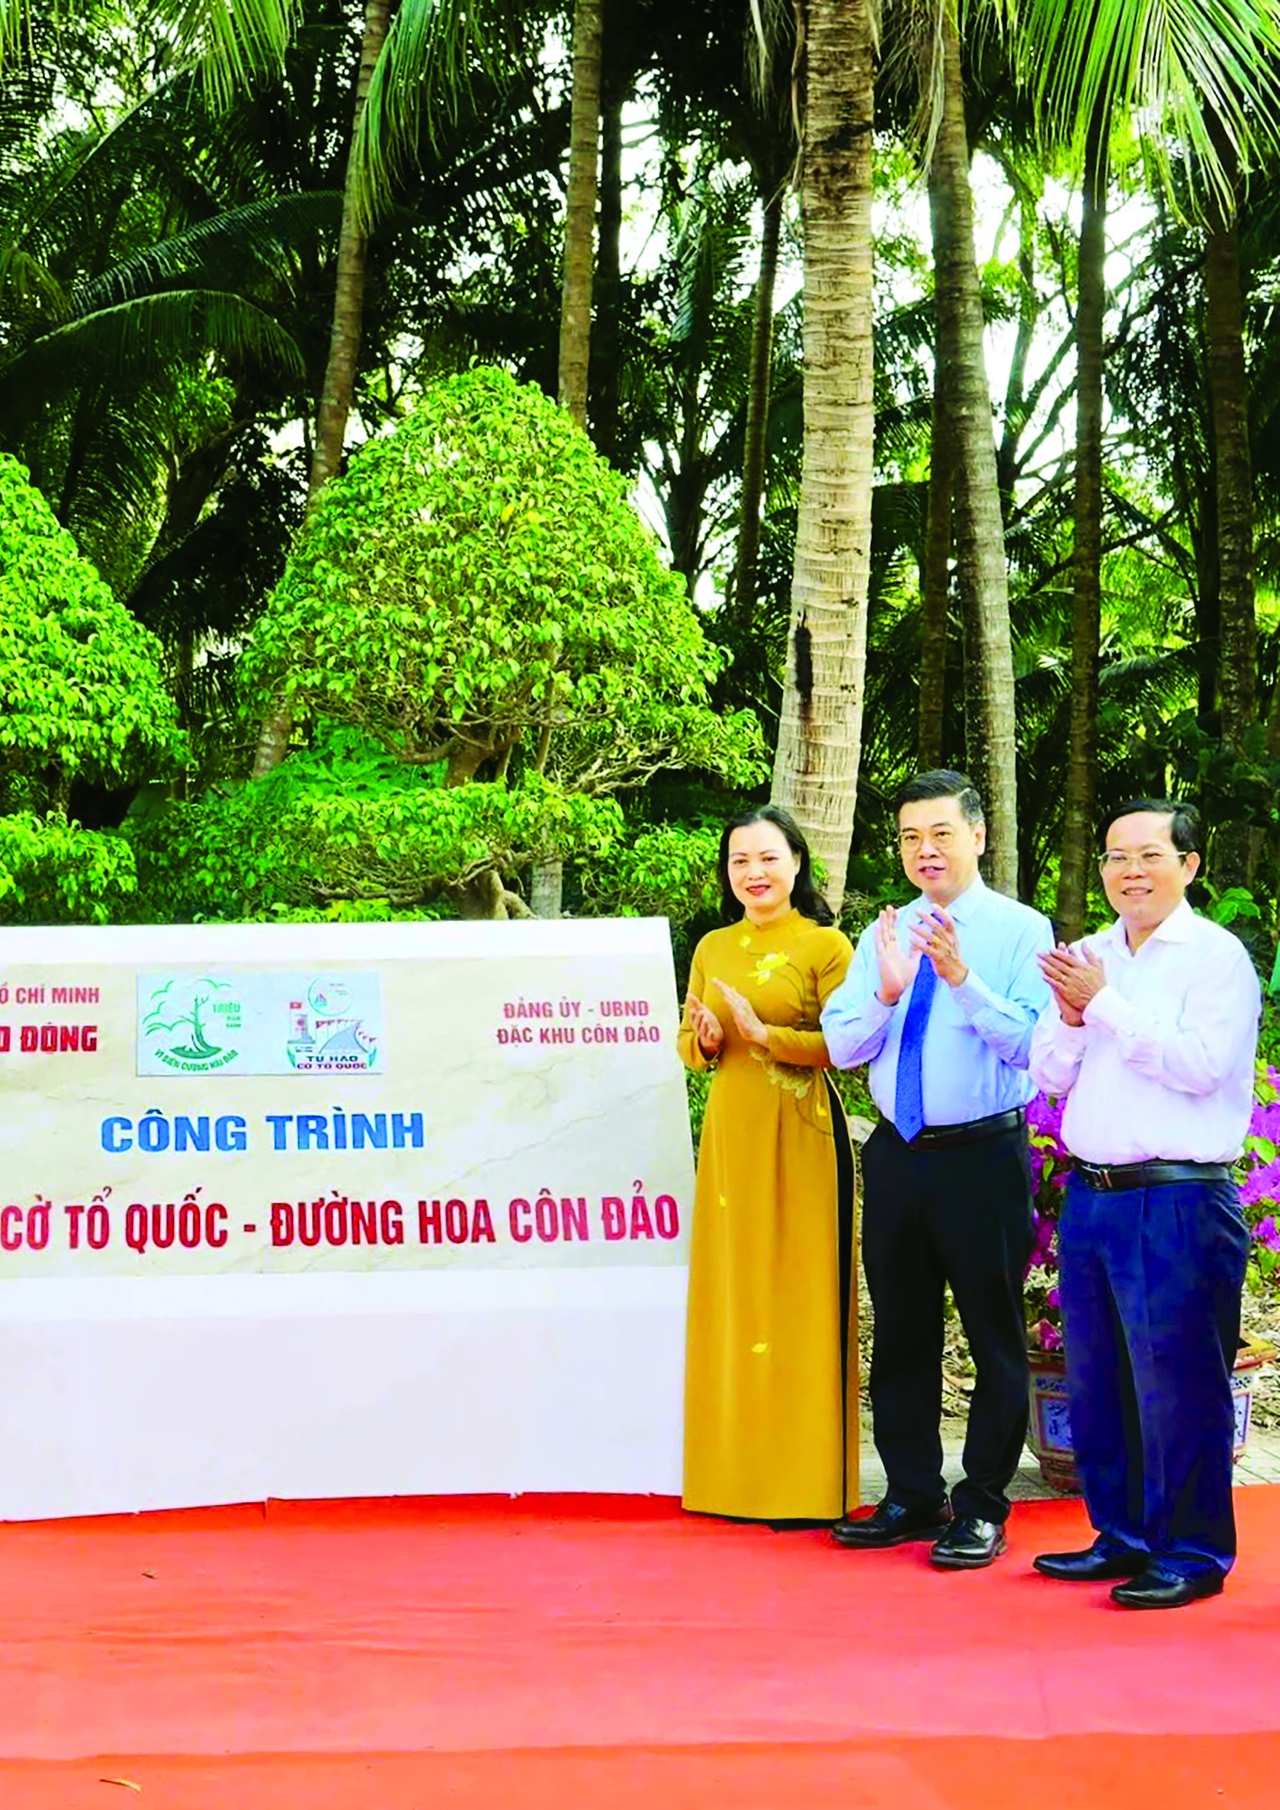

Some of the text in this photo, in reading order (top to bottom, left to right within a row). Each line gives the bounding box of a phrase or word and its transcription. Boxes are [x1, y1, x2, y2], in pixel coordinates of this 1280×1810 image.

[16, 982, 45, 1004] CHÍ
[52, 987, 100, 1004] MINH
[503, 997, 553, 1018] ĐẢNG
[560, 996, 581, 1018] ỦY
[600, 1000, 650, 1017] UBND
[20, 1021, 98, 1055] ĐỘNG
[540, 1028, 575, 1044] KHU
[582, 1023, 618, 1043] CÔN
[101, 1106, 424, 1153] CÔNG TRÌNH
[0, 1195, 52, 1251] CỜ
[64, 1186, 113, 1251] TỔ
[125, 1186, 228, 1254] QUỐC
[270, 1191, 405, 1246] ĐƯỜNG
[419, 1199, 496, 1244] HOA
[509, 1188, 589, 1242] CÔN
[601, 1179, 680, 1240] ĐẢO
